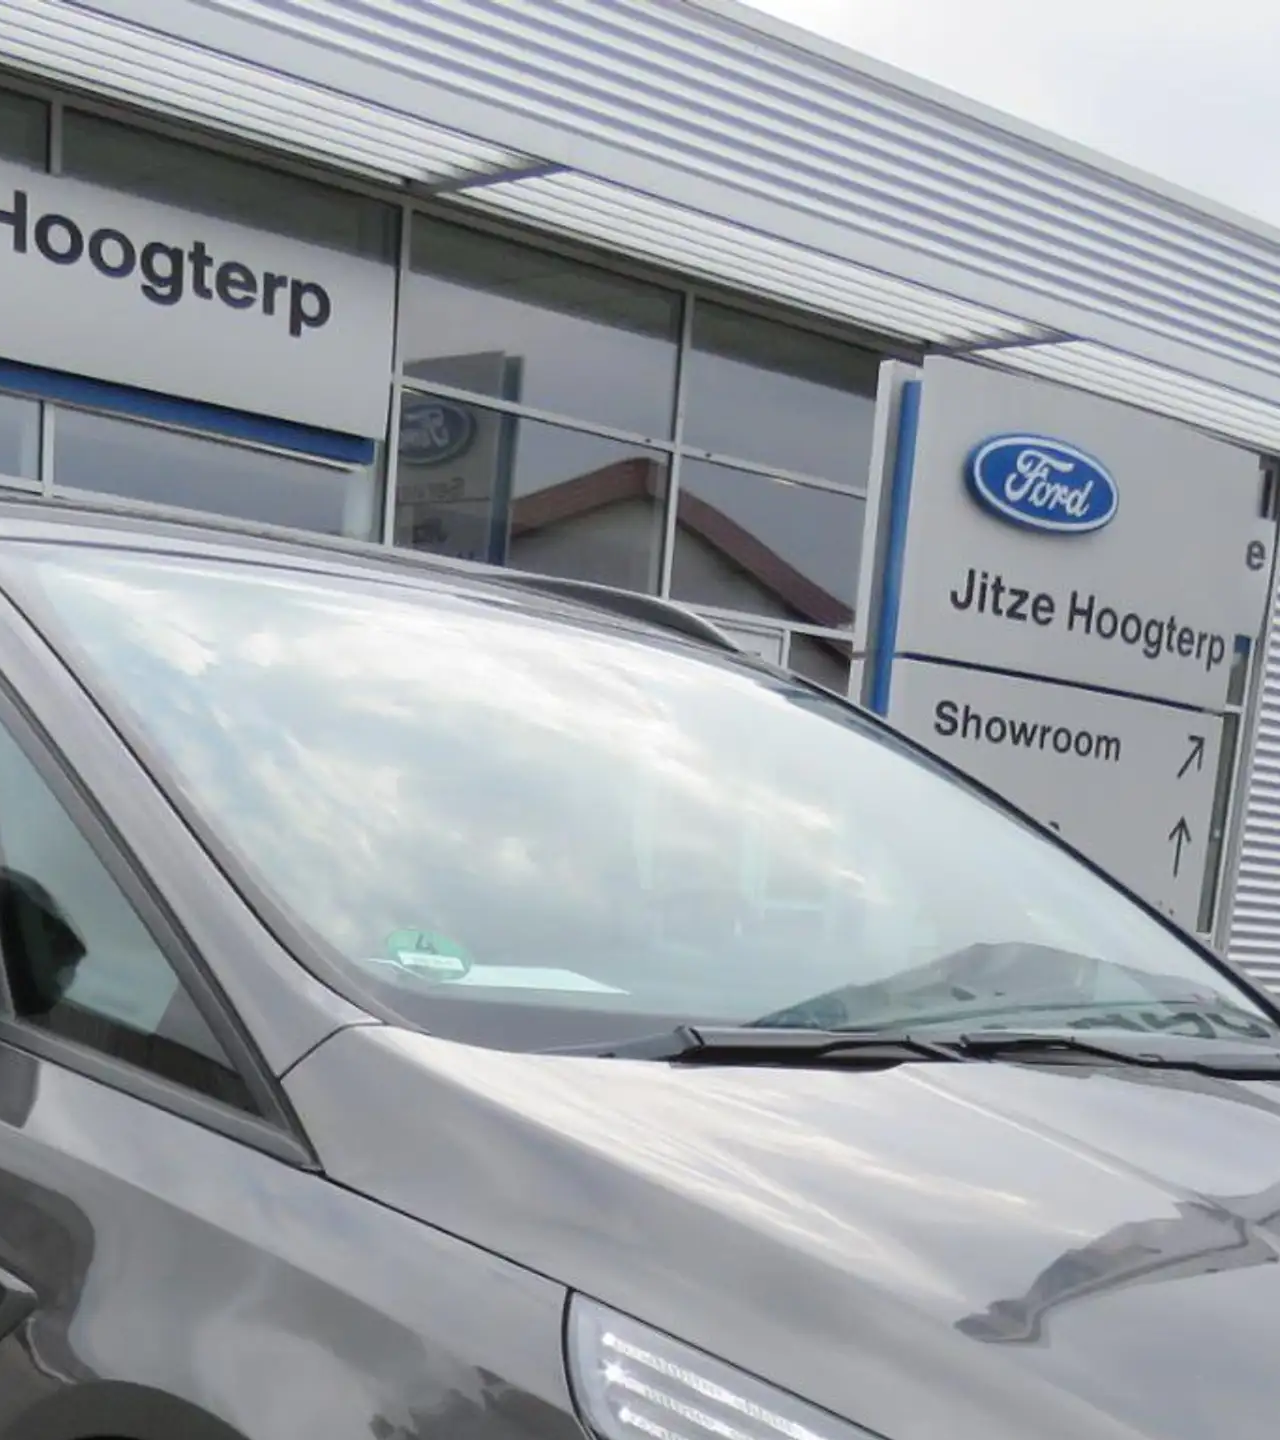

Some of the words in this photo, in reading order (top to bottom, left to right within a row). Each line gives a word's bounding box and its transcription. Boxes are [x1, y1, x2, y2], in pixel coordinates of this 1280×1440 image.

[1003, 448, 1095, 518] Ford
[950, 568, 1056, 626] Jitze
[1067, 590, 1226, 672] Hoogterp
[934, 700, 1122, 762] Showroom
